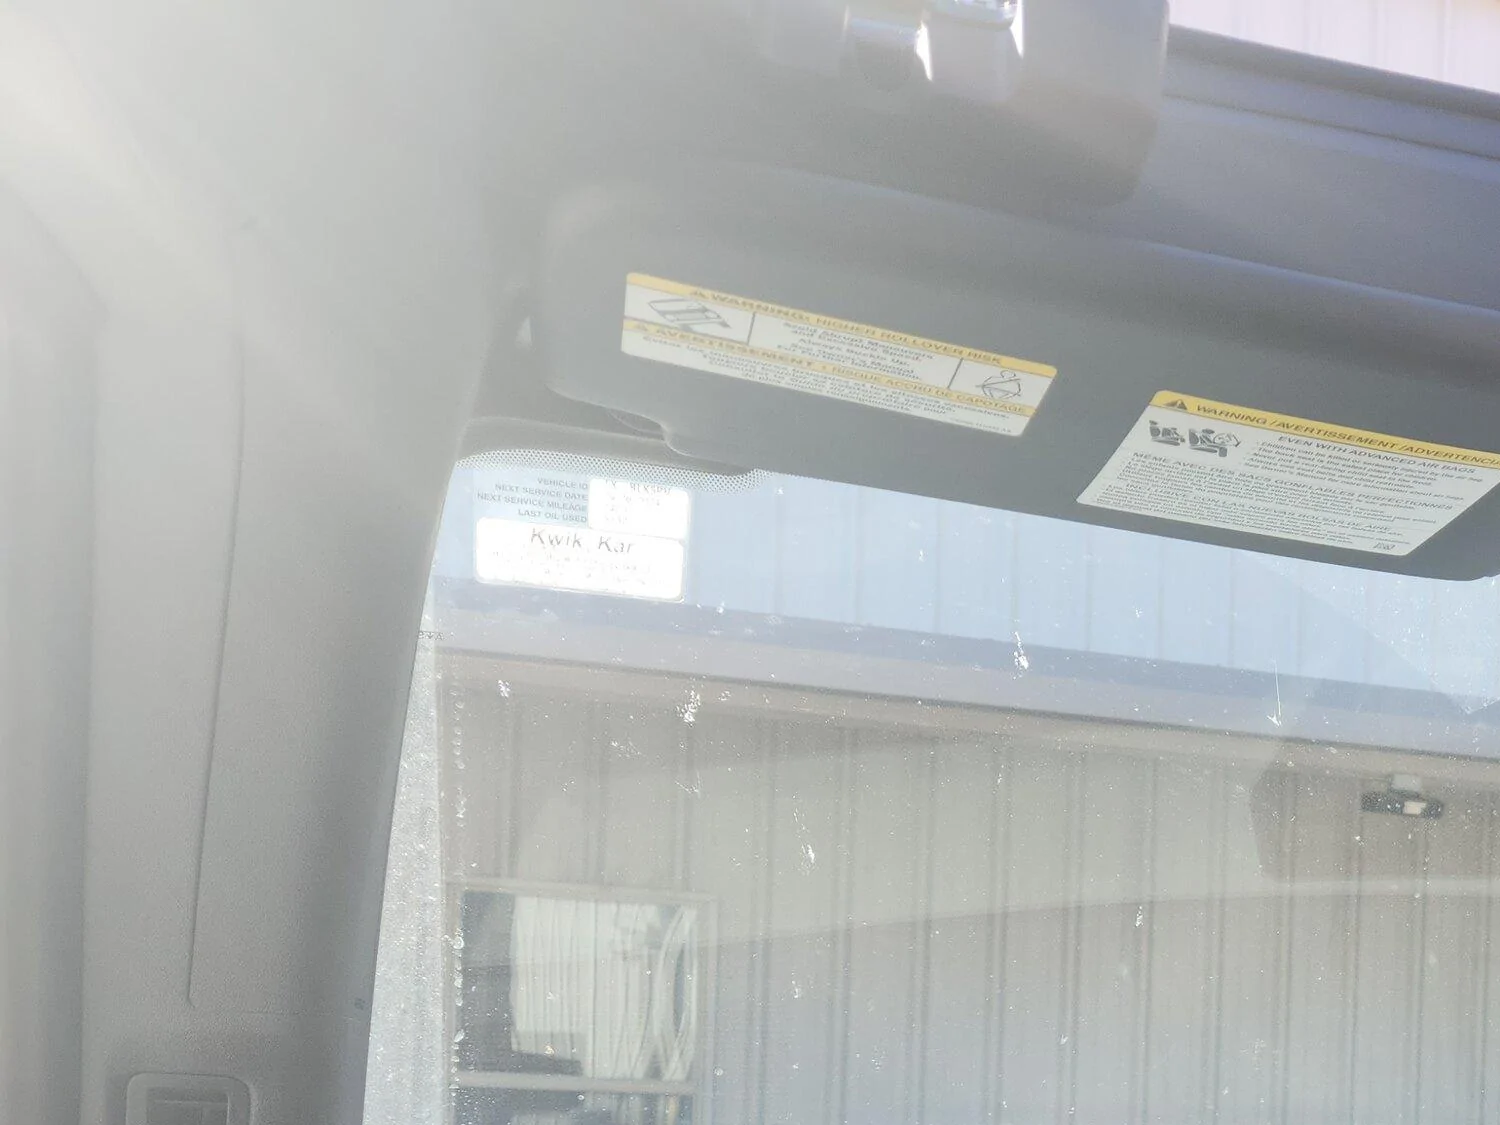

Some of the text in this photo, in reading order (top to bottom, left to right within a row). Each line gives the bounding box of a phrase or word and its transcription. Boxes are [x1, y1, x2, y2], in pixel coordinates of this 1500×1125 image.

[1191, 403, 1271, 425] WARNING
[494, 483, 589, 501] NEXT SERVICE DATE
[537, 477, 588, 490] VEHICLE ID
[477, 491, 502, 502] NEXT
[504, 495, 543, 507] SERVICE
[518, 508, 587, 523] LAST OIL USED
[530, 527, 582, 548] Kwik
